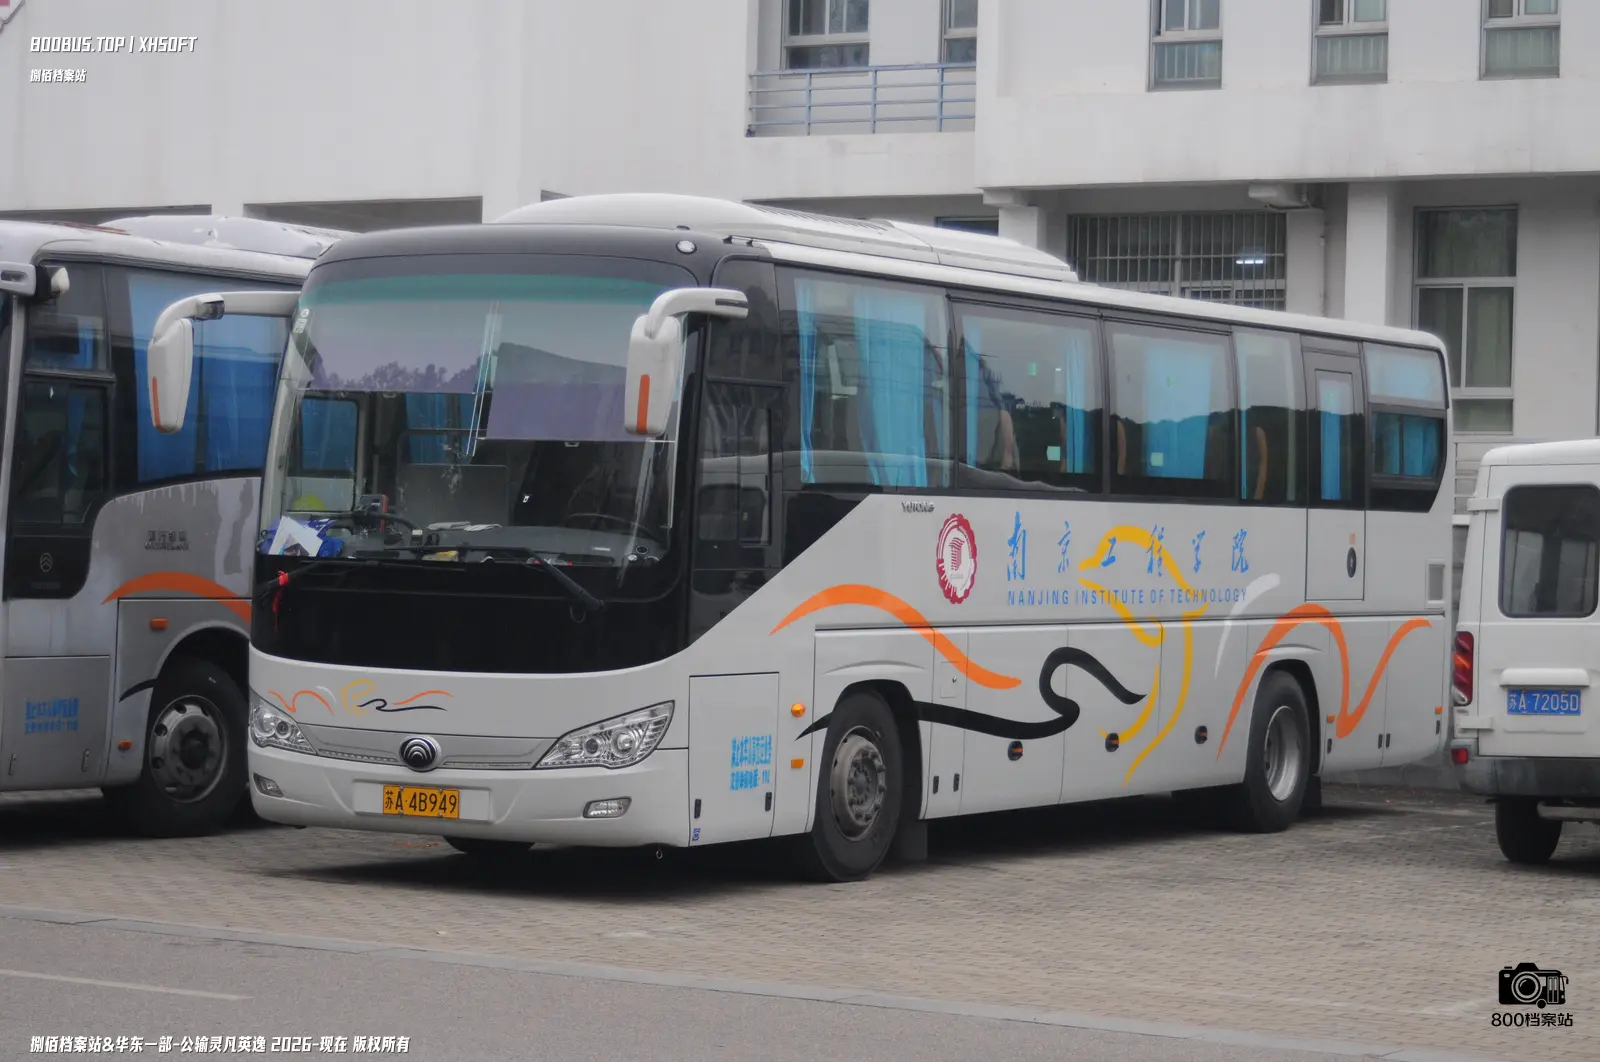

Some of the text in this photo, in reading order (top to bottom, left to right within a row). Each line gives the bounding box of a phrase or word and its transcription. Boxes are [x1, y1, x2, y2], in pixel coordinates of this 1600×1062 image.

[1007, 587, 1247, 606] NANJING INSTITUTE OF TECHNOLOGY
